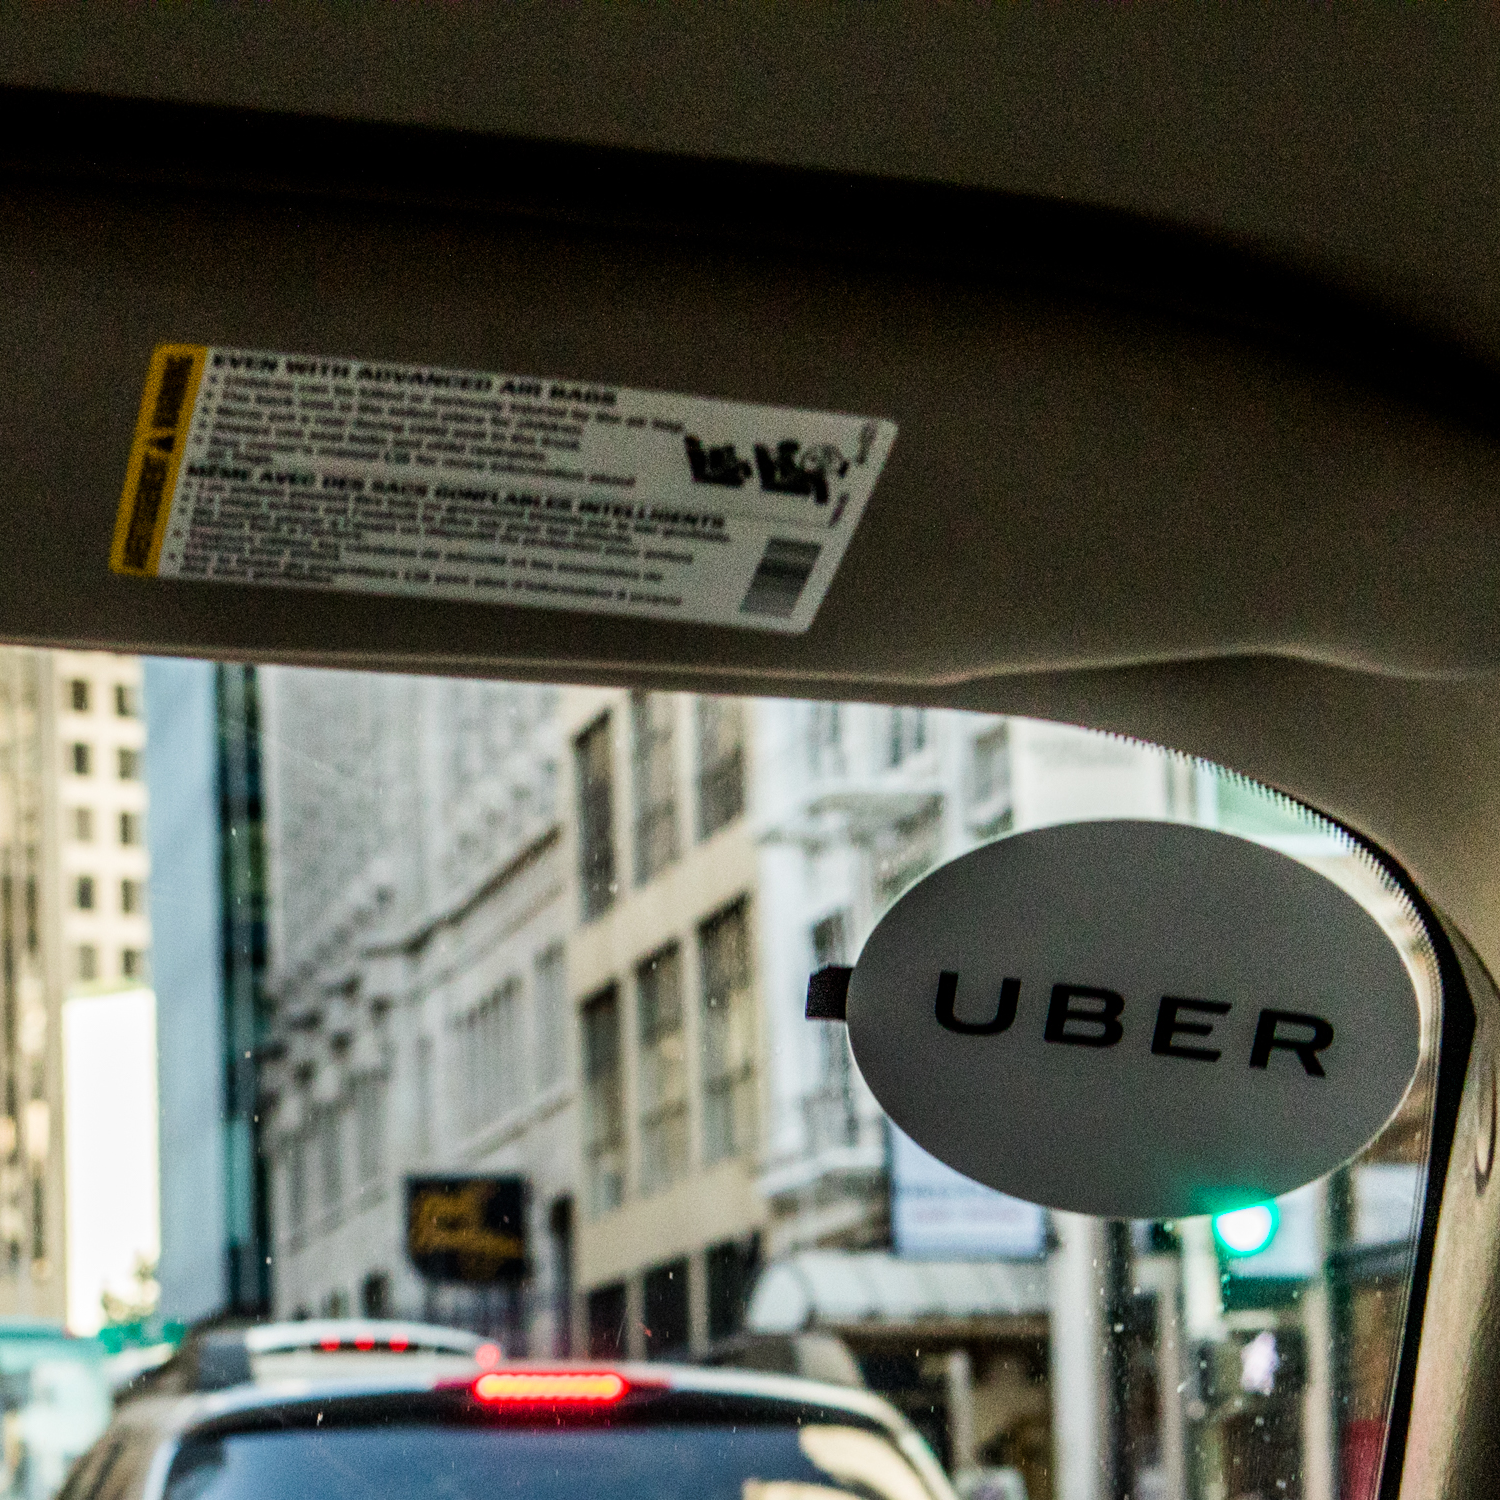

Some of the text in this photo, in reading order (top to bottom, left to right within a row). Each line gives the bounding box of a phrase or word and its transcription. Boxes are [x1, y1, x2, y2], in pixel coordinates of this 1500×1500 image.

[285, 360, 349, 378] WITH
[501, 378, 543, 398] AIR
[933, 970, 1335, 1078] UBER
